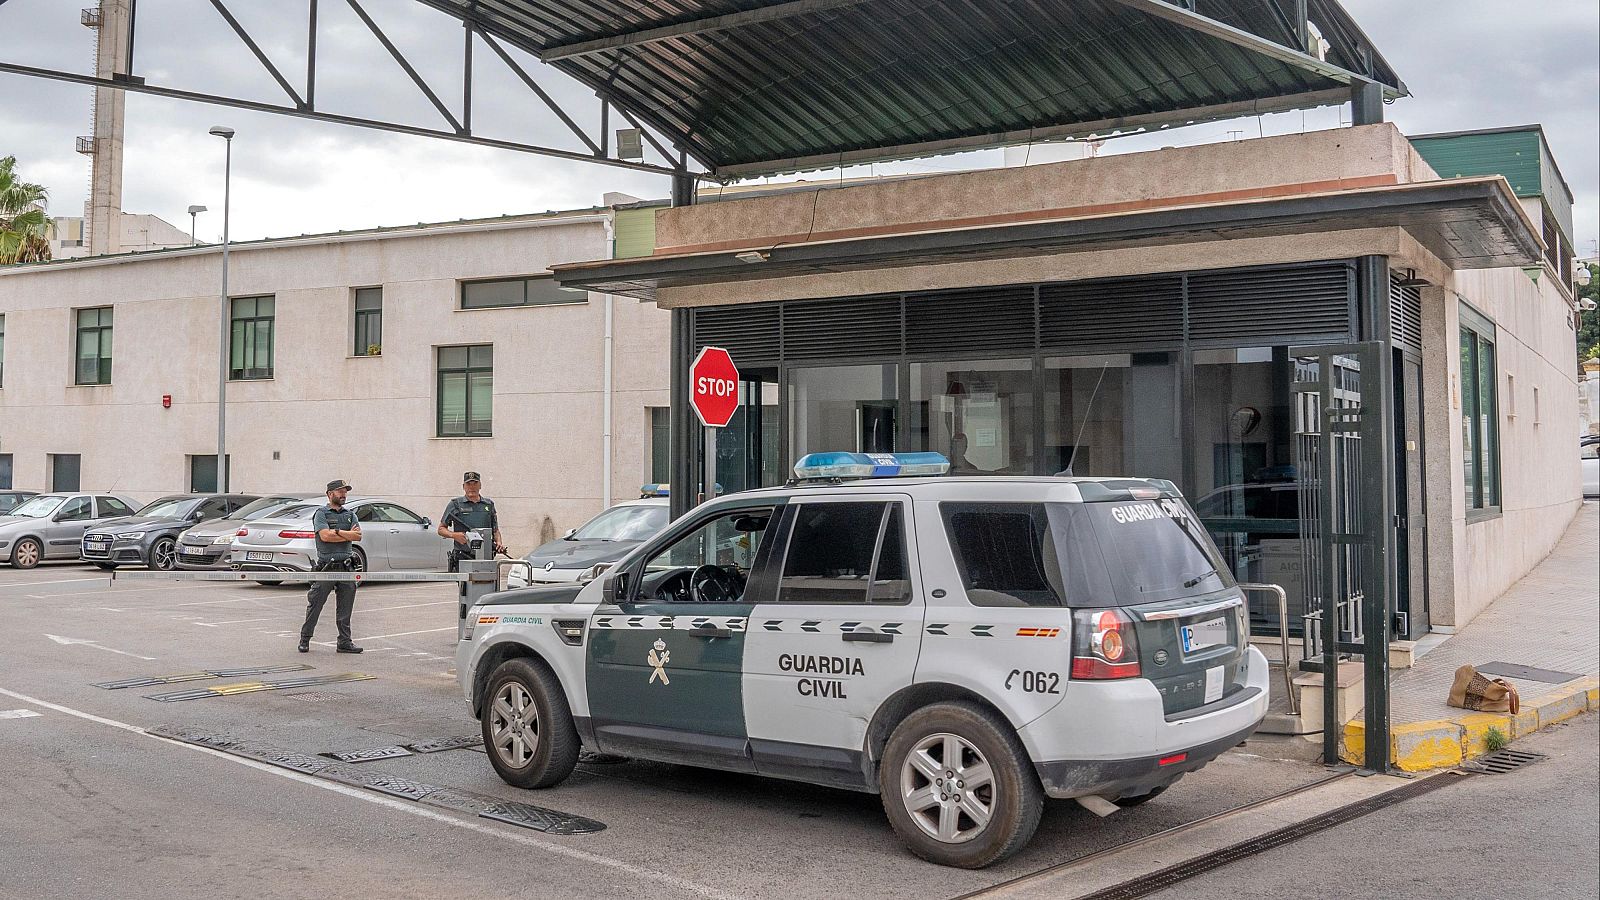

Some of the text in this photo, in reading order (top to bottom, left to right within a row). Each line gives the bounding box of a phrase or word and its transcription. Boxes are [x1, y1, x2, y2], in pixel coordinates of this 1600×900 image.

[697, 376, 735, 397] STOP
[1111, 502, 1165, 524] GUARDIA
[502, 616, 543, 625] GUARDIA CIVIL
[778, 653, 865, 676] GUARDIA
[797, 678, 847, 699] CIVIL
[1022, 670, 1060, 695] 062
